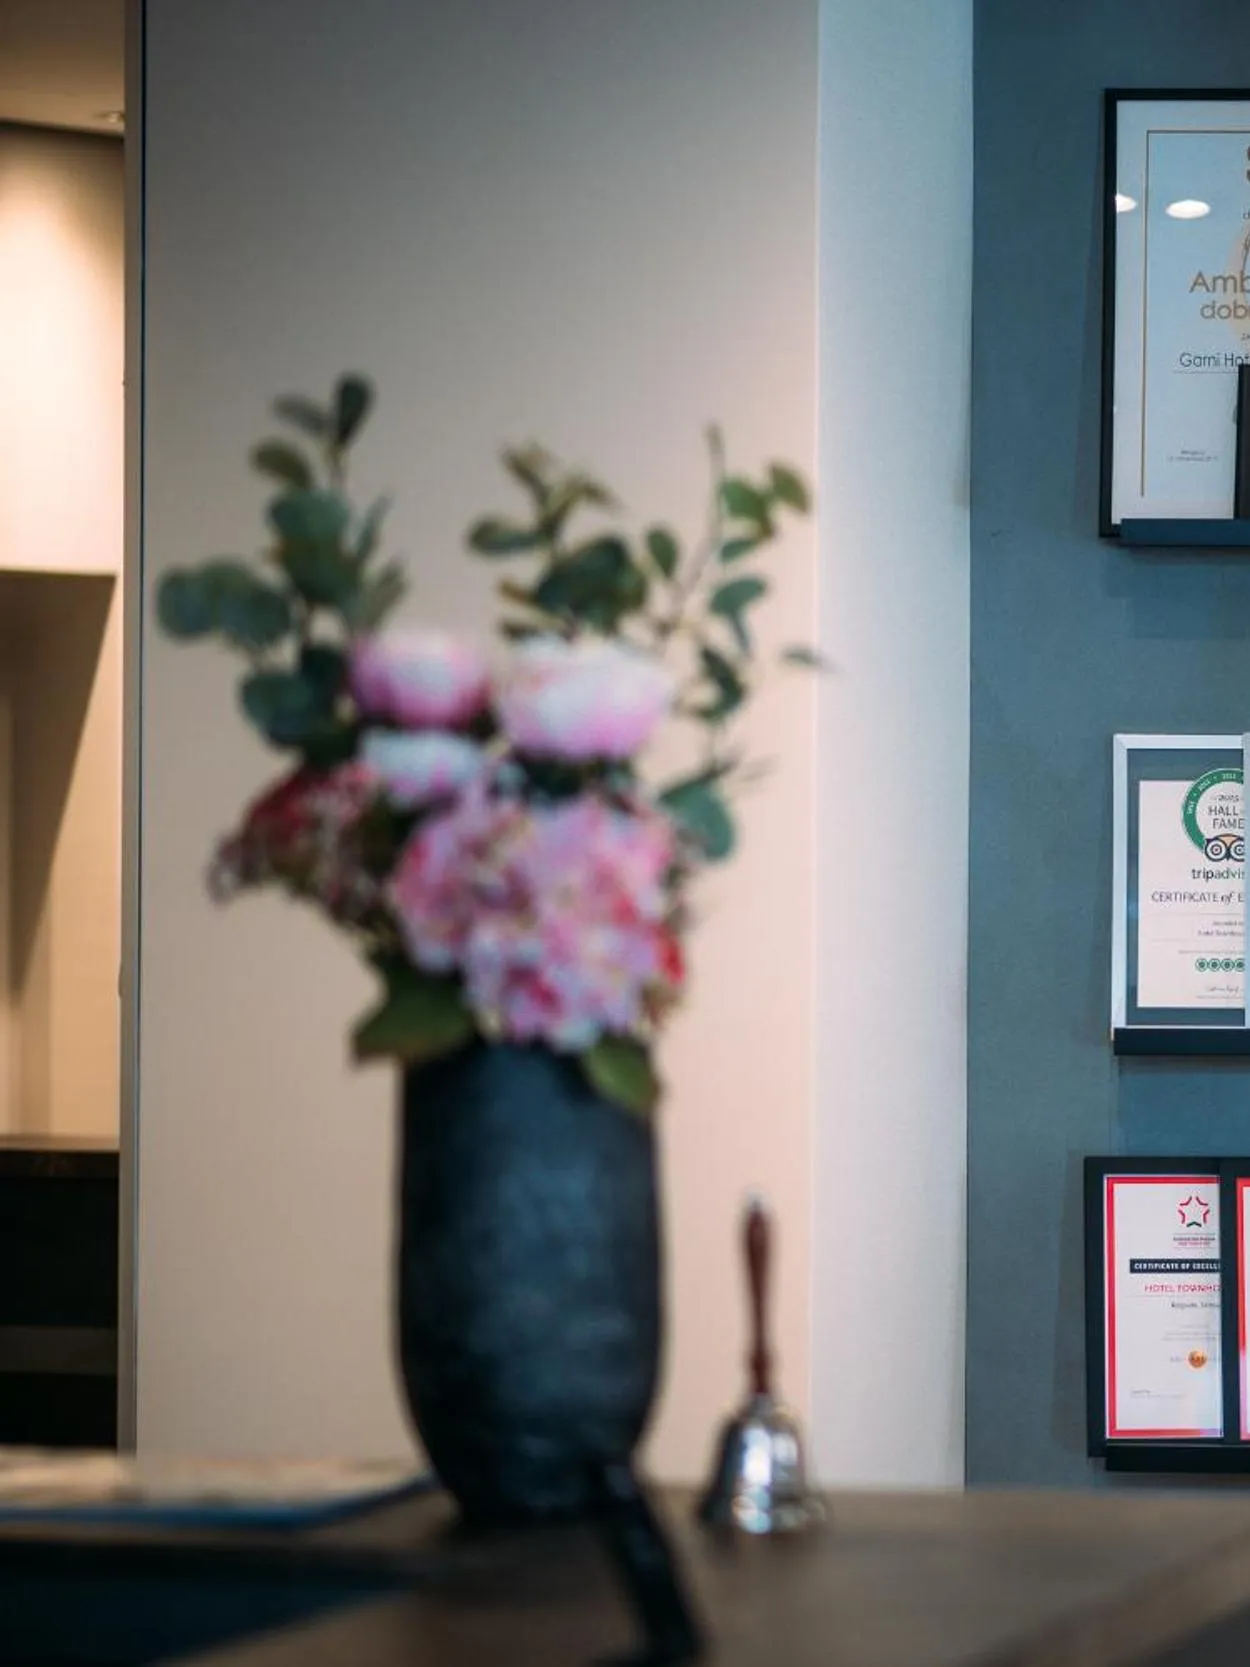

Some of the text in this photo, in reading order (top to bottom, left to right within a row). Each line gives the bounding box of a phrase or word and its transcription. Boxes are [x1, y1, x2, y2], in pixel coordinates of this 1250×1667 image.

[1179, 351, 1221, 368] Garni
[1208, 805, 1239, 816] HALL
[1191, 867, 1245, 883] tripadvi
[1151, 890, 1219, 903] CERTIFICATE
[1134, 1262, 1179, 1270] CERTIFICATE
[1144, 1284, 1175, 1293] HOTEL
